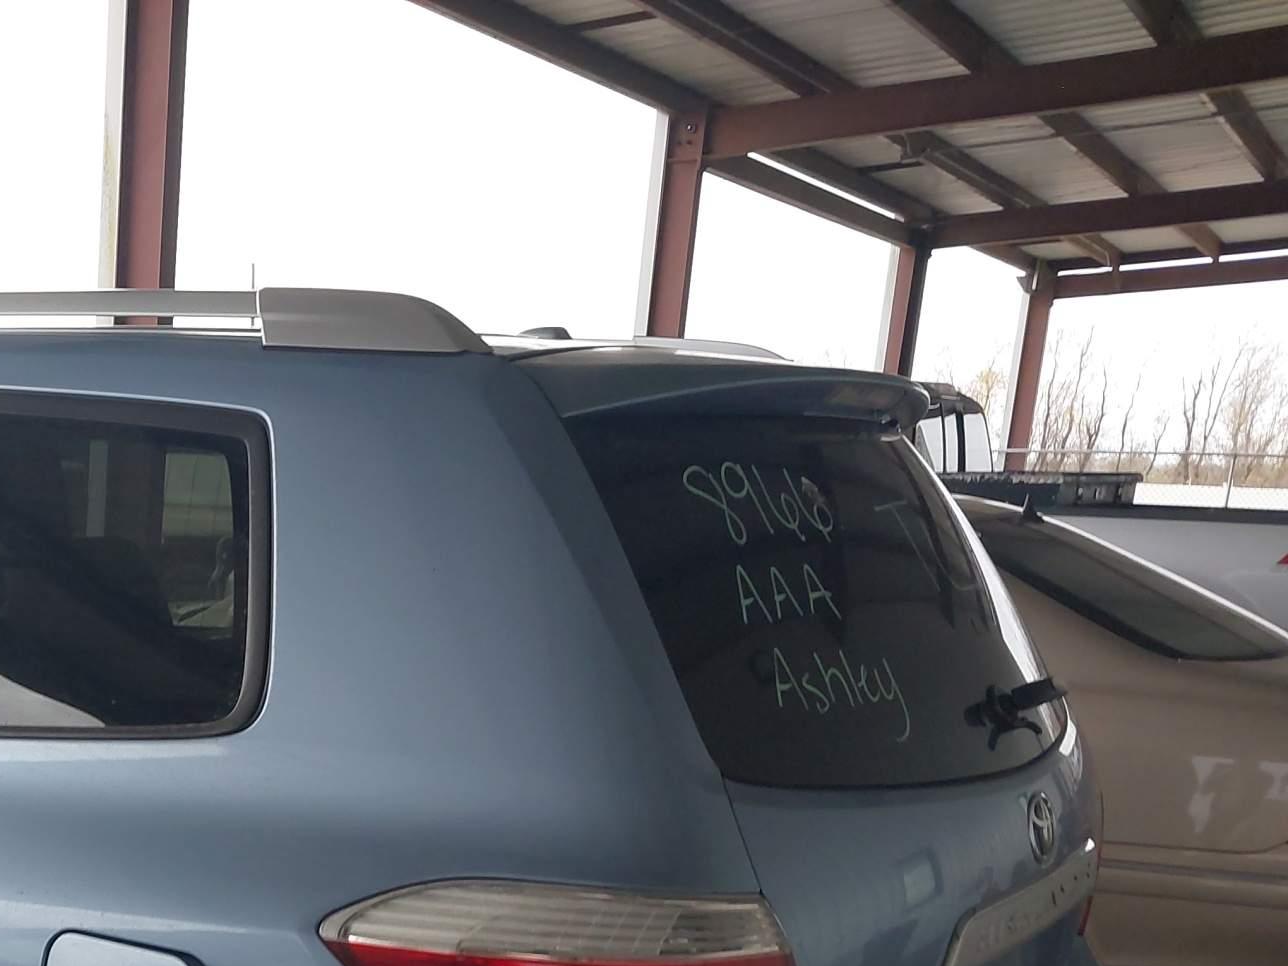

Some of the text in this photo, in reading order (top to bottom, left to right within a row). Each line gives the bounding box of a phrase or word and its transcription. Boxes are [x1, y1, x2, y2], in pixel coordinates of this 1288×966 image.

[682, 461, 834, 544] 8966
[735, 563, 842, 625] AAA
[773, 647, 911, 743] Ashley
